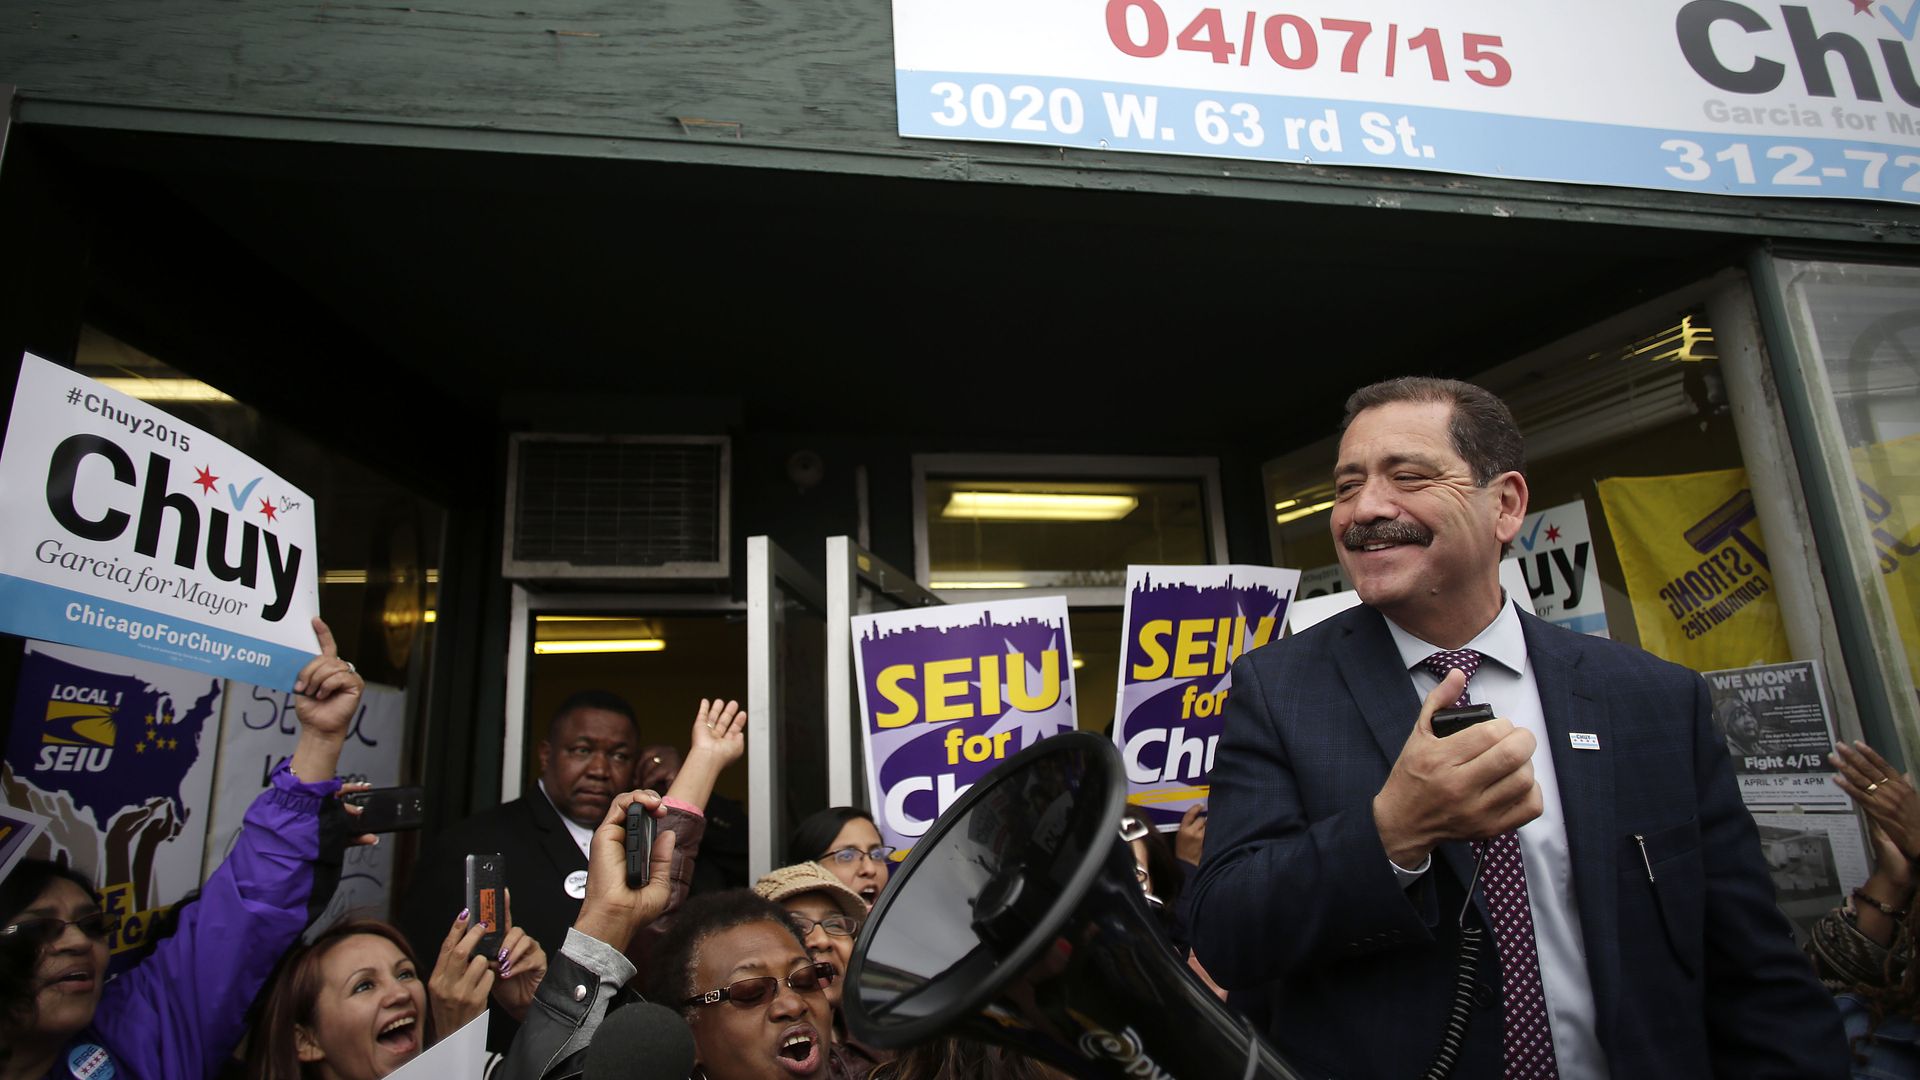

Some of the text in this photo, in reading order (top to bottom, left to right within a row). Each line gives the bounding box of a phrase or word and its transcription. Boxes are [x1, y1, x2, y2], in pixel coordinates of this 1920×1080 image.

[1105, 0, 1512, 87] 04/07/15
[1676, 0, 1920, 108] Chu
[930, 82, 1436, 159] 3020 W. 63 rd St.
[1703, 99, 1823, 128] Garcia
[1831, 106, 1877, 131] for
[1660, 139, 1920, 193] 312-72
[66, 387, 191, 452] #Chuy2015
[46, 433, 302, 622] Chuy
[35, 539, 248, 617] Garcia for Mayor
[65, 602, 272, 668] ChicagoForChuy.com
[51, 684, 123, 706] LOCAL 1
[875, 648, 1061, 729] SEIU
[1181, 685, 1228, 720] for
[1711, 668, 1807, 690] WE WON'T
[1739, 686, 1786, 702] WAIT
[34, 745, 114, 772] SEIU
[944, 728, 1011, 766] for
[1122, 726, 1219, 783] Ch
[1744, 753, 1821, 770] Fight 4/15
[1744, 778, 1770, 787] APRIL
[1804, 777, 1824, 785] 4PM
